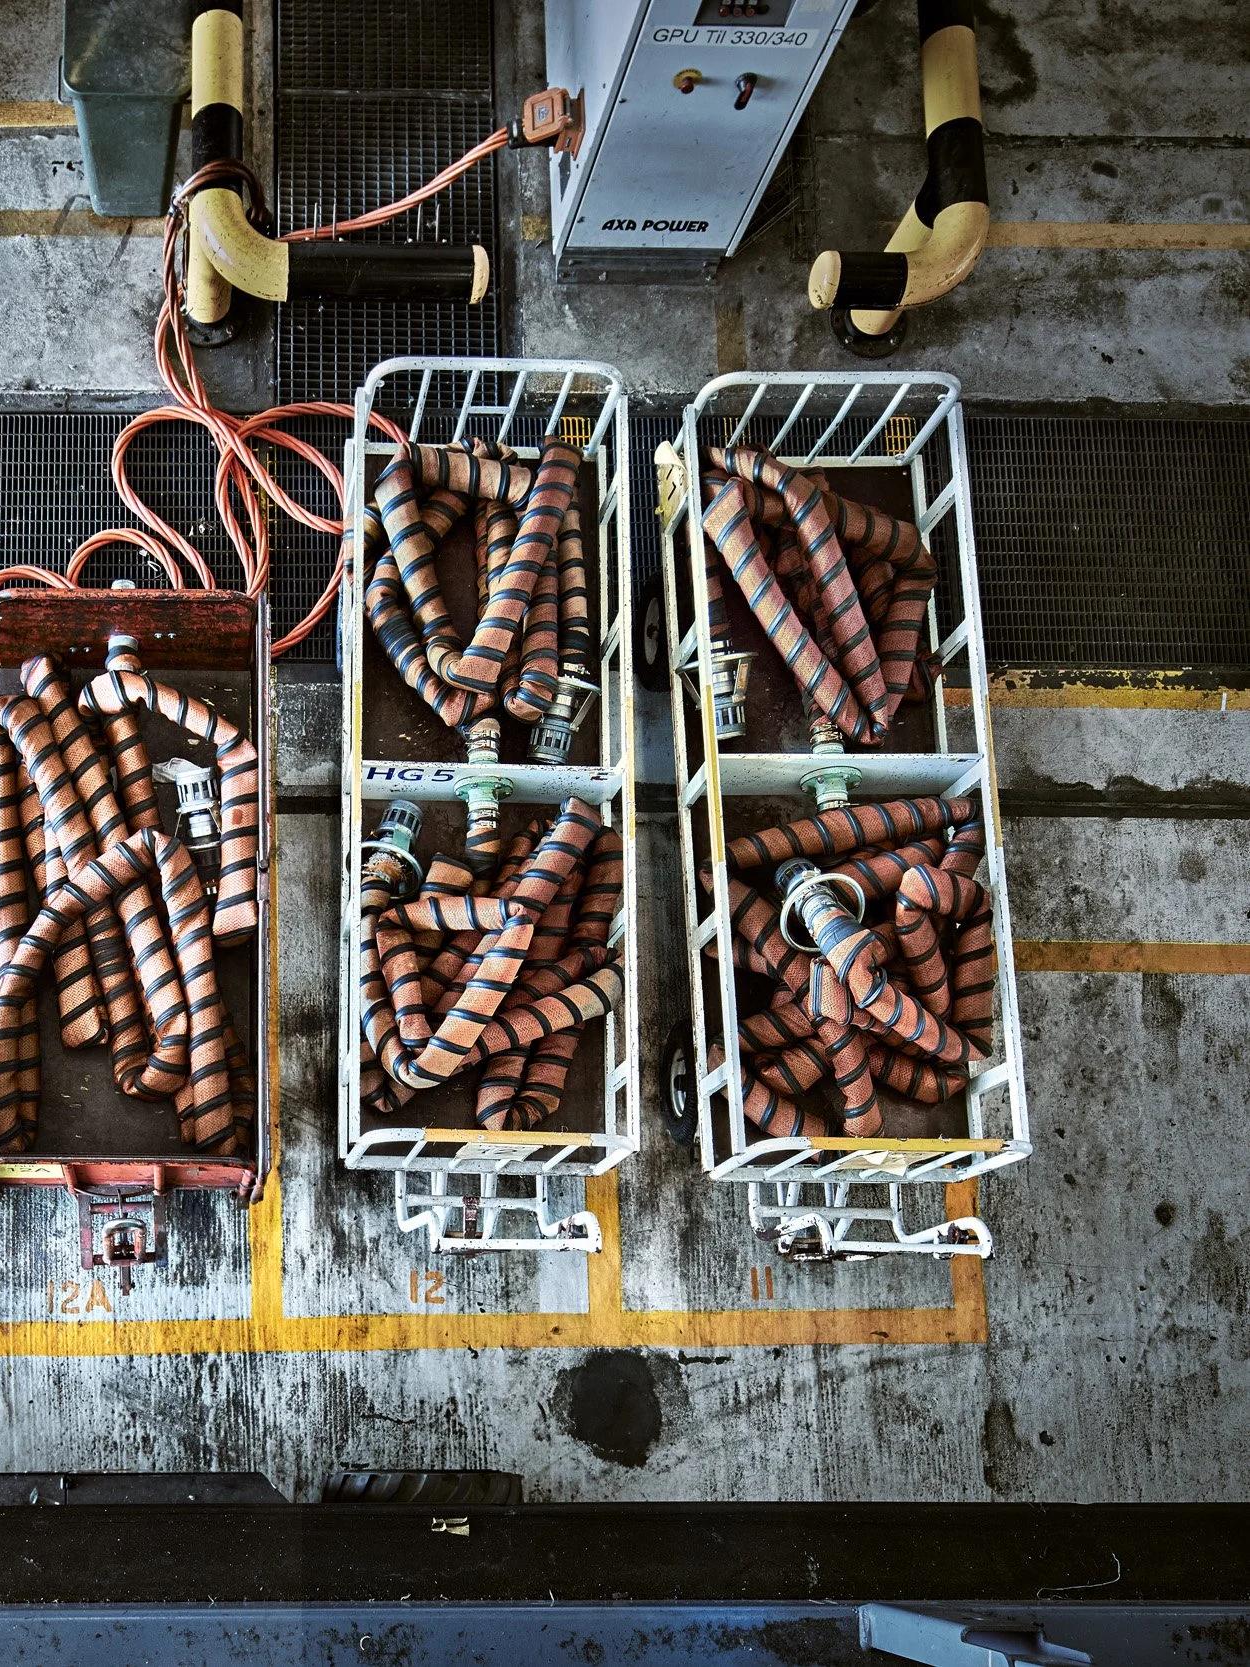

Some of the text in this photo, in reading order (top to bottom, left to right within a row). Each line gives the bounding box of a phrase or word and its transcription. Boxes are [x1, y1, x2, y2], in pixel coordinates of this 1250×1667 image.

[653, 28, 699, 43] GPU
[730, 30, 808, 46] 330/340
[601, 218, 710, 233] AXA POWER
[47, 1279, 113, 1314] 12A
[410, 1270, 445, 1304] 12
[751, 1265, 775, 1300] 11
